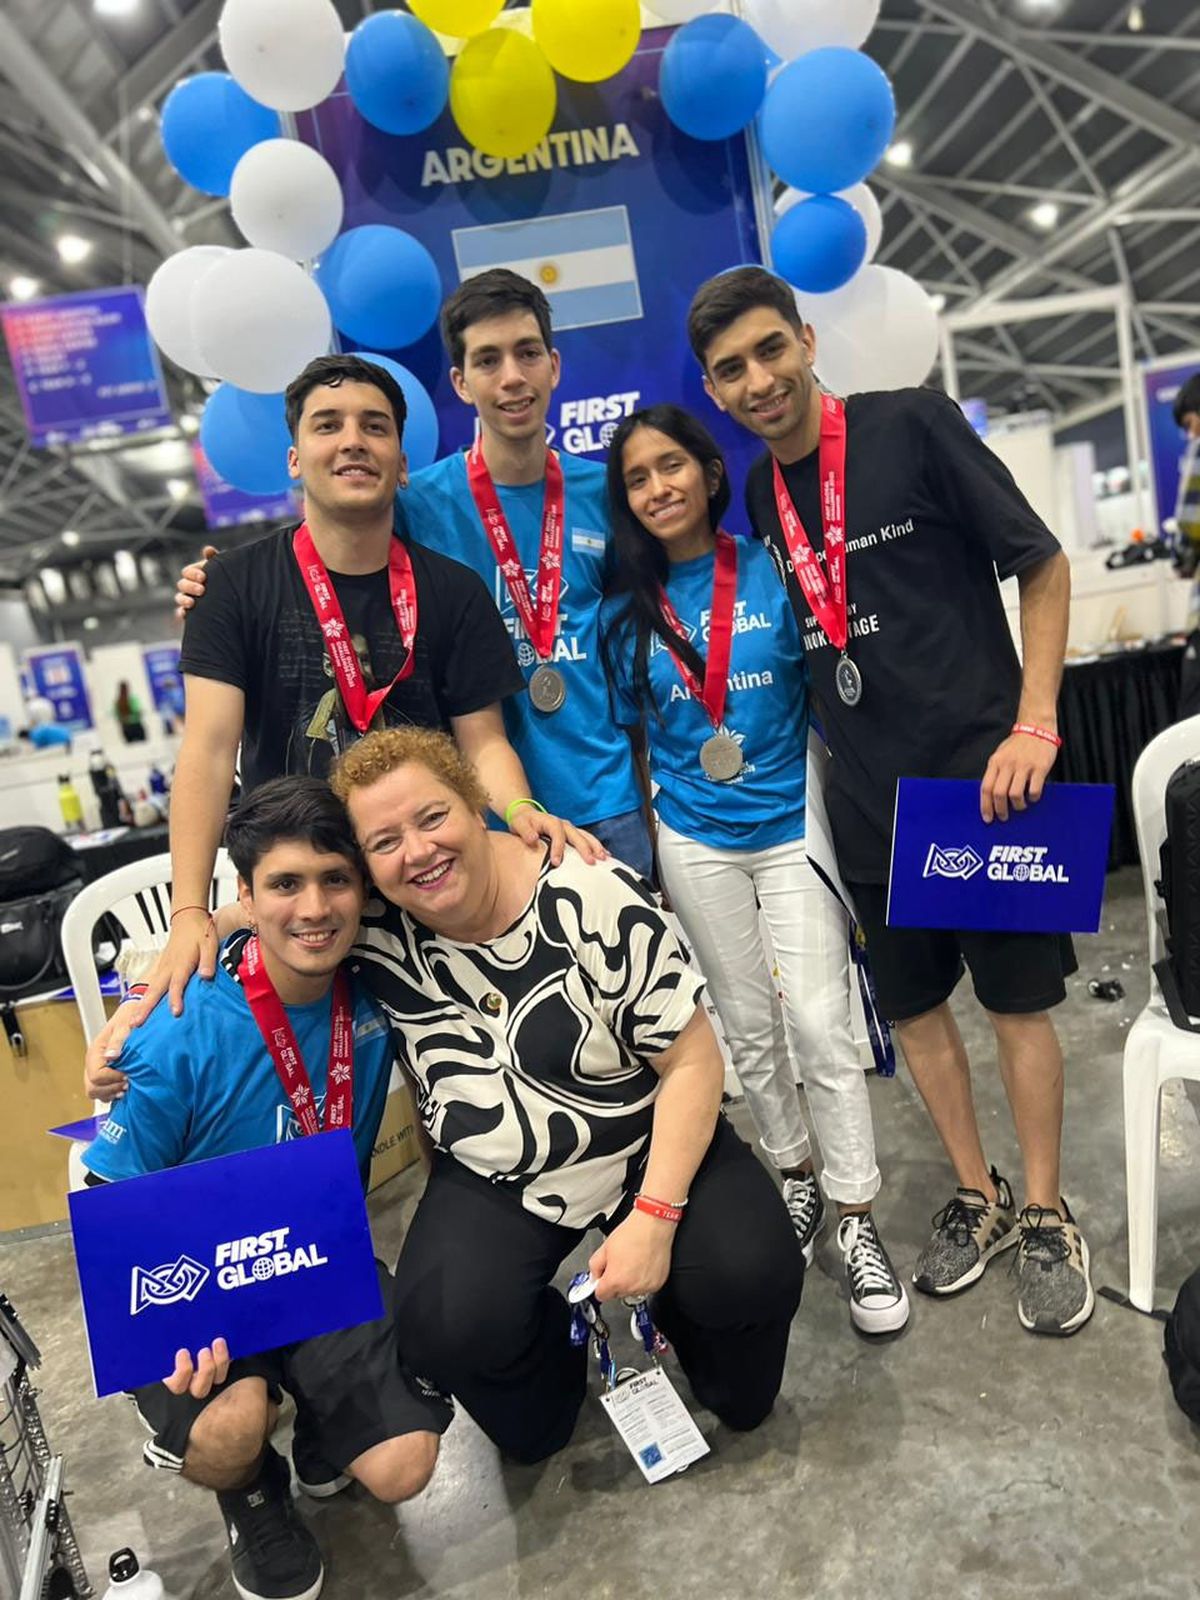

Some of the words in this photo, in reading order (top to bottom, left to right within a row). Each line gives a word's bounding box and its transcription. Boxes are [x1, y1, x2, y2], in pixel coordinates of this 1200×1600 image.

[421, 123, 640, 187] ARGENTINA
[560, 391, 640, 429] FIRST
[845, 534, 877, 553] man
[880, 518, 914, 542] Kind
[670, 670, 774, 702] Arntina
[988, 845, 1048, 864] FIRST
[986, 863, 1070, 883] GLOBAL
[215, 1227, 290, 1267] FIRST
[217, 1244, 328, 1290] GLOBAL
[629, 1377, 647, 1389] FIRST
